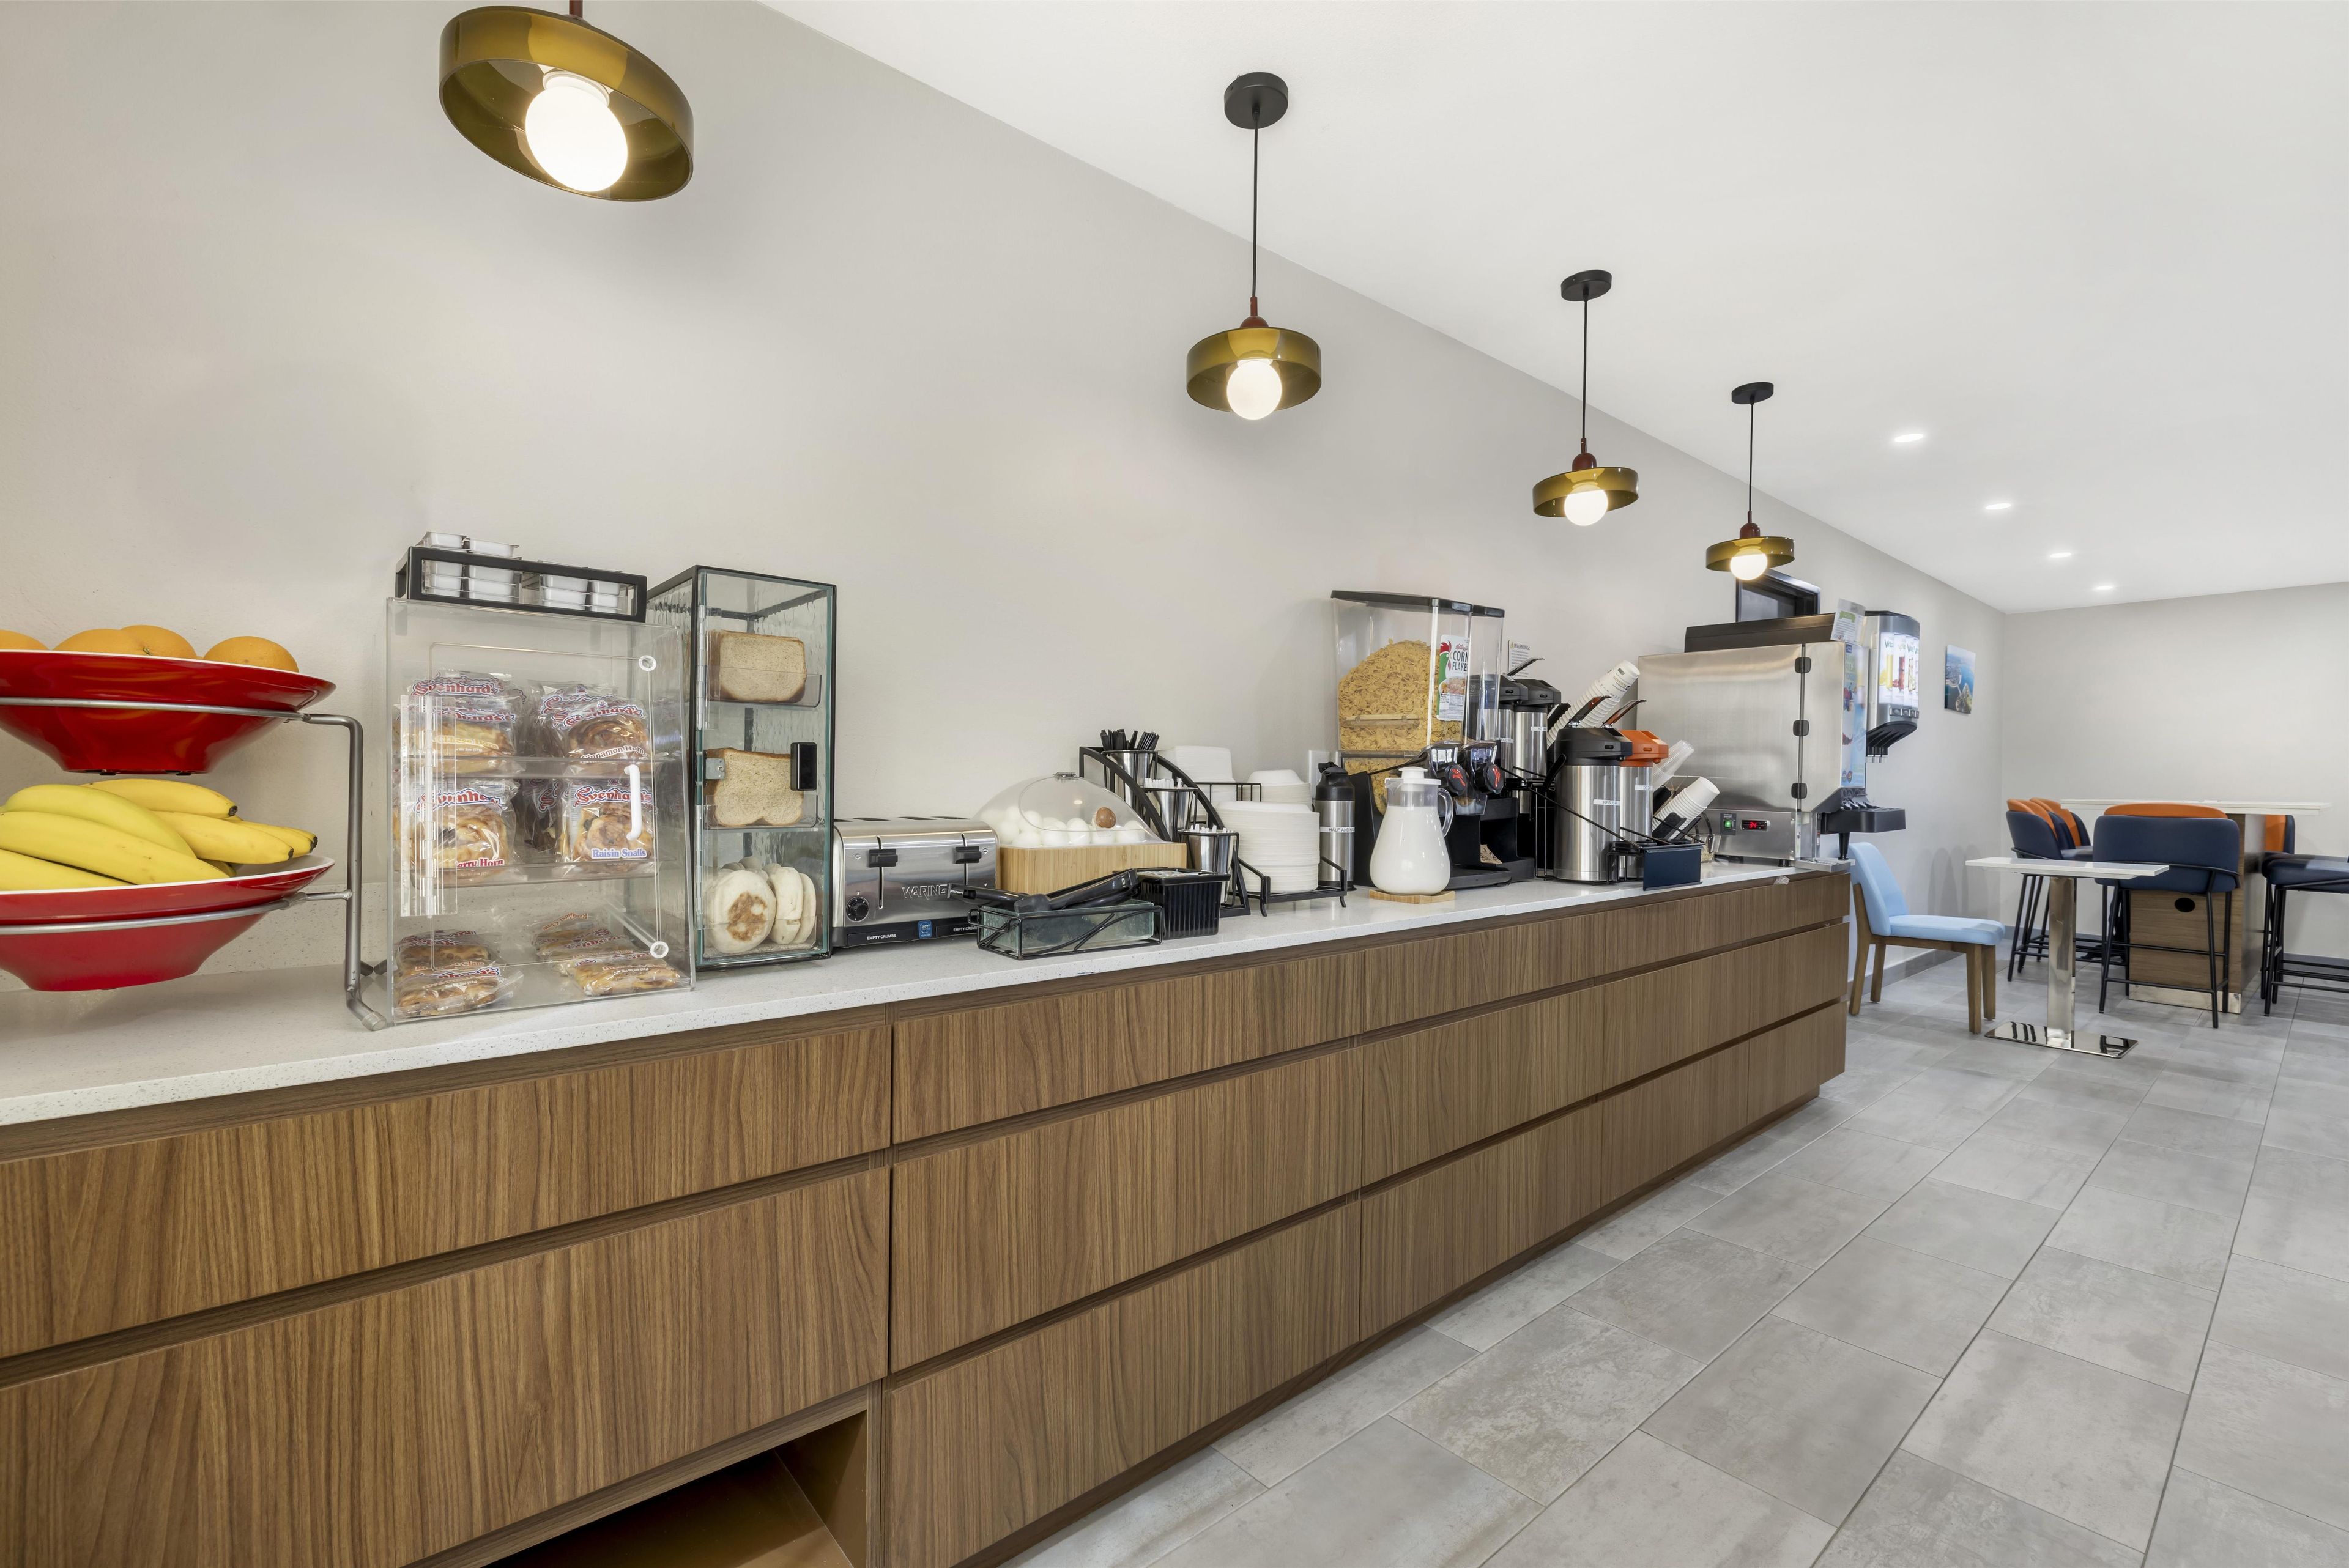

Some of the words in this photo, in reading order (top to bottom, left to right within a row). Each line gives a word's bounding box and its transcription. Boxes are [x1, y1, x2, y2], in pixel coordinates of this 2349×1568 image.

[582, 747, 624, 759] Cinnamon
[573, 786, 652, 807] Svenha's
[592, 849, 620, 857] Raisin
[622, 848, 646, 857] Snails
[480, 858, 503, 867] Horn
[902, 884, 948, 900] WARING
